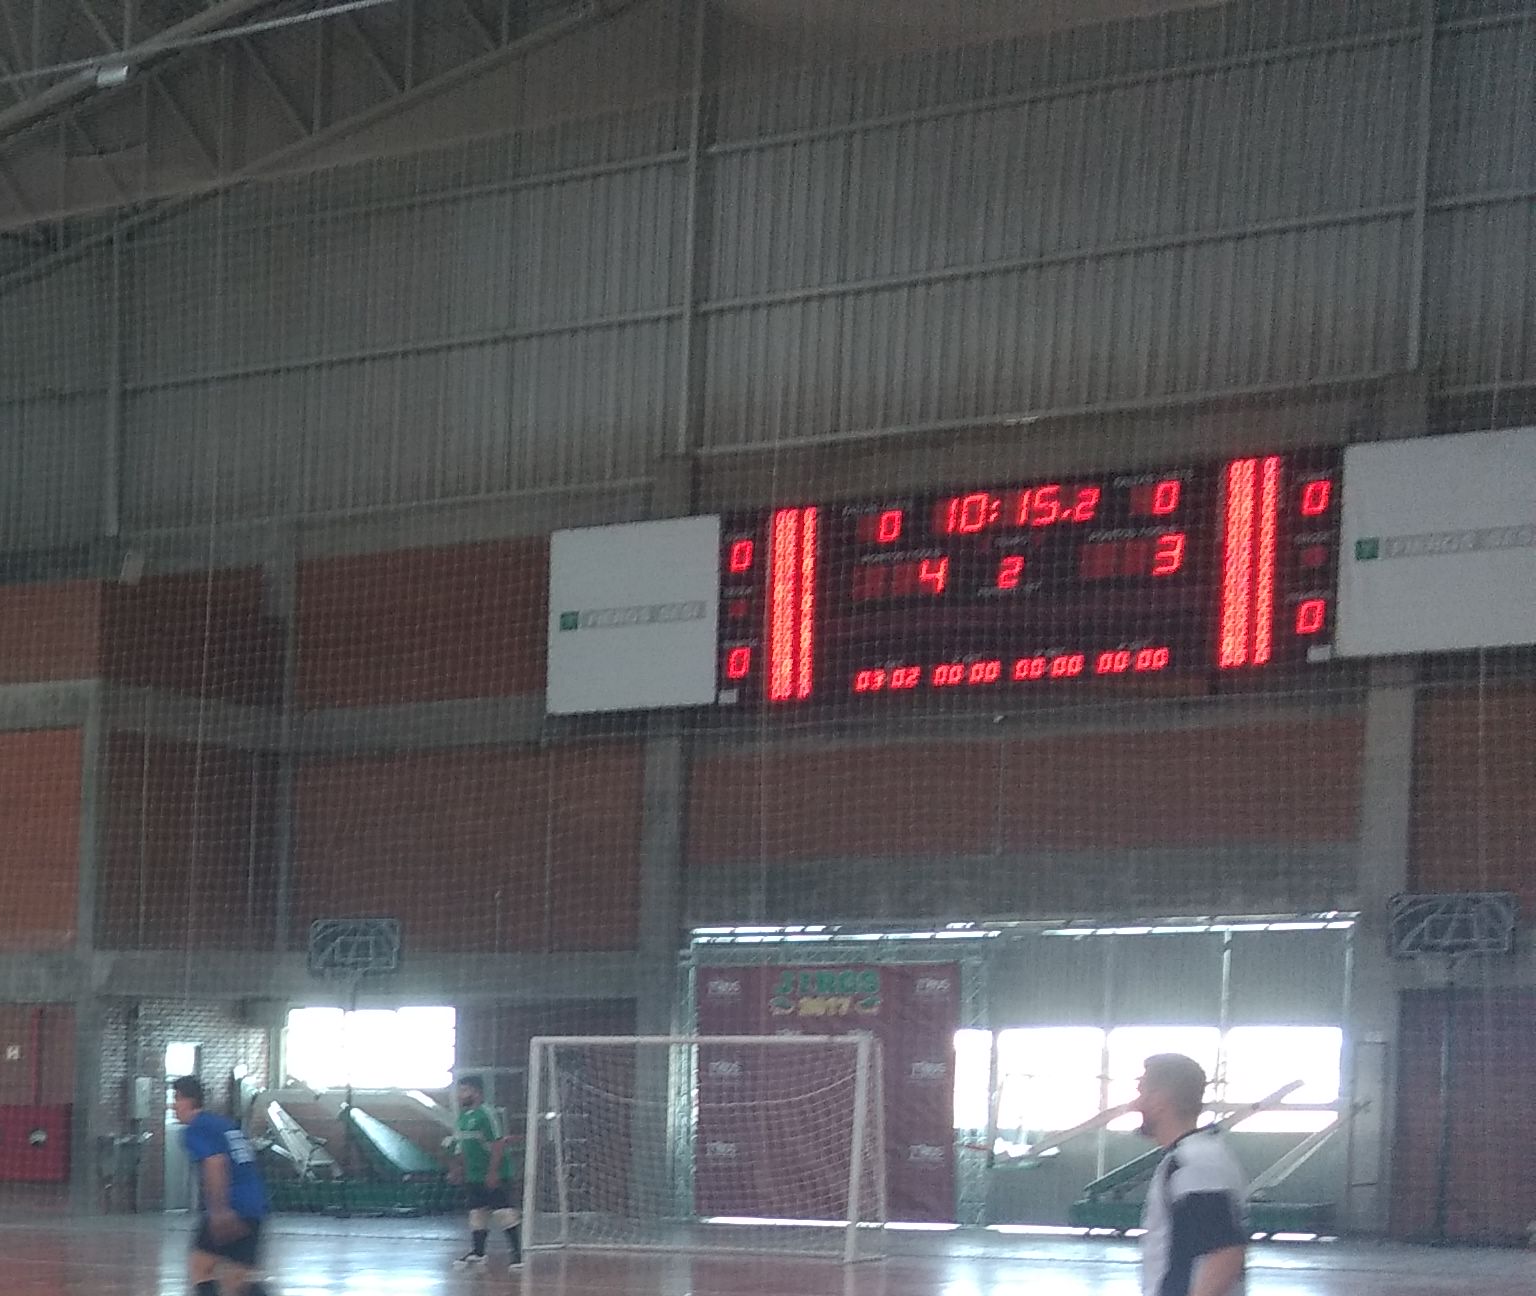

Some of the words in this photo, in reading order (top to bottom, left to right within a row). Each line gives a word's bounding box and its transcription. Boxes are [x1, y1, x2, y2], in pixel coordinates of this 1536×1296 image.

[1151, 479, 1179, 515] 0
[1301, 477, 1330, 516] 0
[878, 510, 902, 542] 0
[730, 539, 754, 573] 0
[1152, 532, 1185, 576] 3
[918, 556, 949, 595] 4
[996, 555, 1024, 589] 2
[1295, 599, 1325, 634] 0
[727, 647, 752, 680] 0
